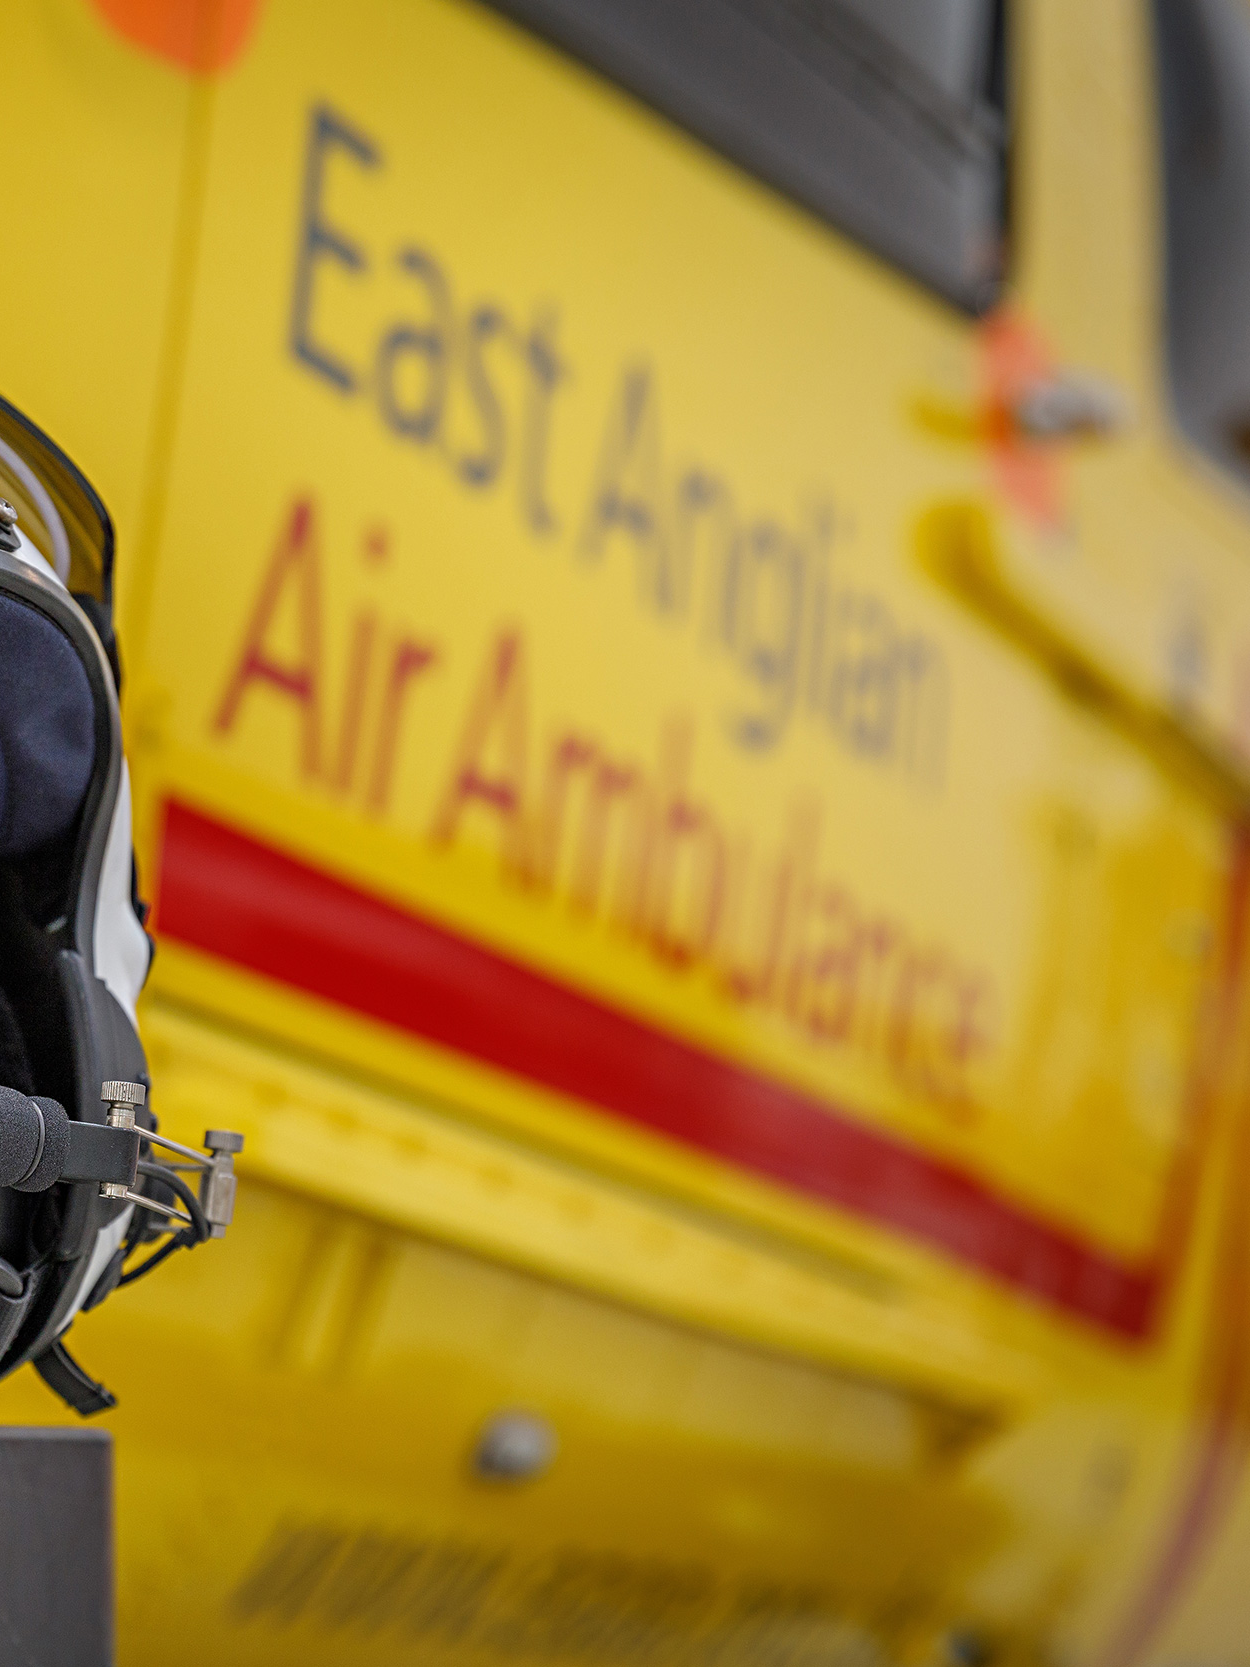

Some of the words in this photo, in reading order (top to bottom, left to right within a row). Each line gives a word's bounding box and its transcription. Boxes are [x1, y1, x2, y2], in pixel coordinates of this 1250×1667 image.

[286, 98, 568, 540] East
[578, 356, 950, 796] Anglian
[209, 494, 438, 820] Air
[426, 618, 1001, 1126] Ambulance
